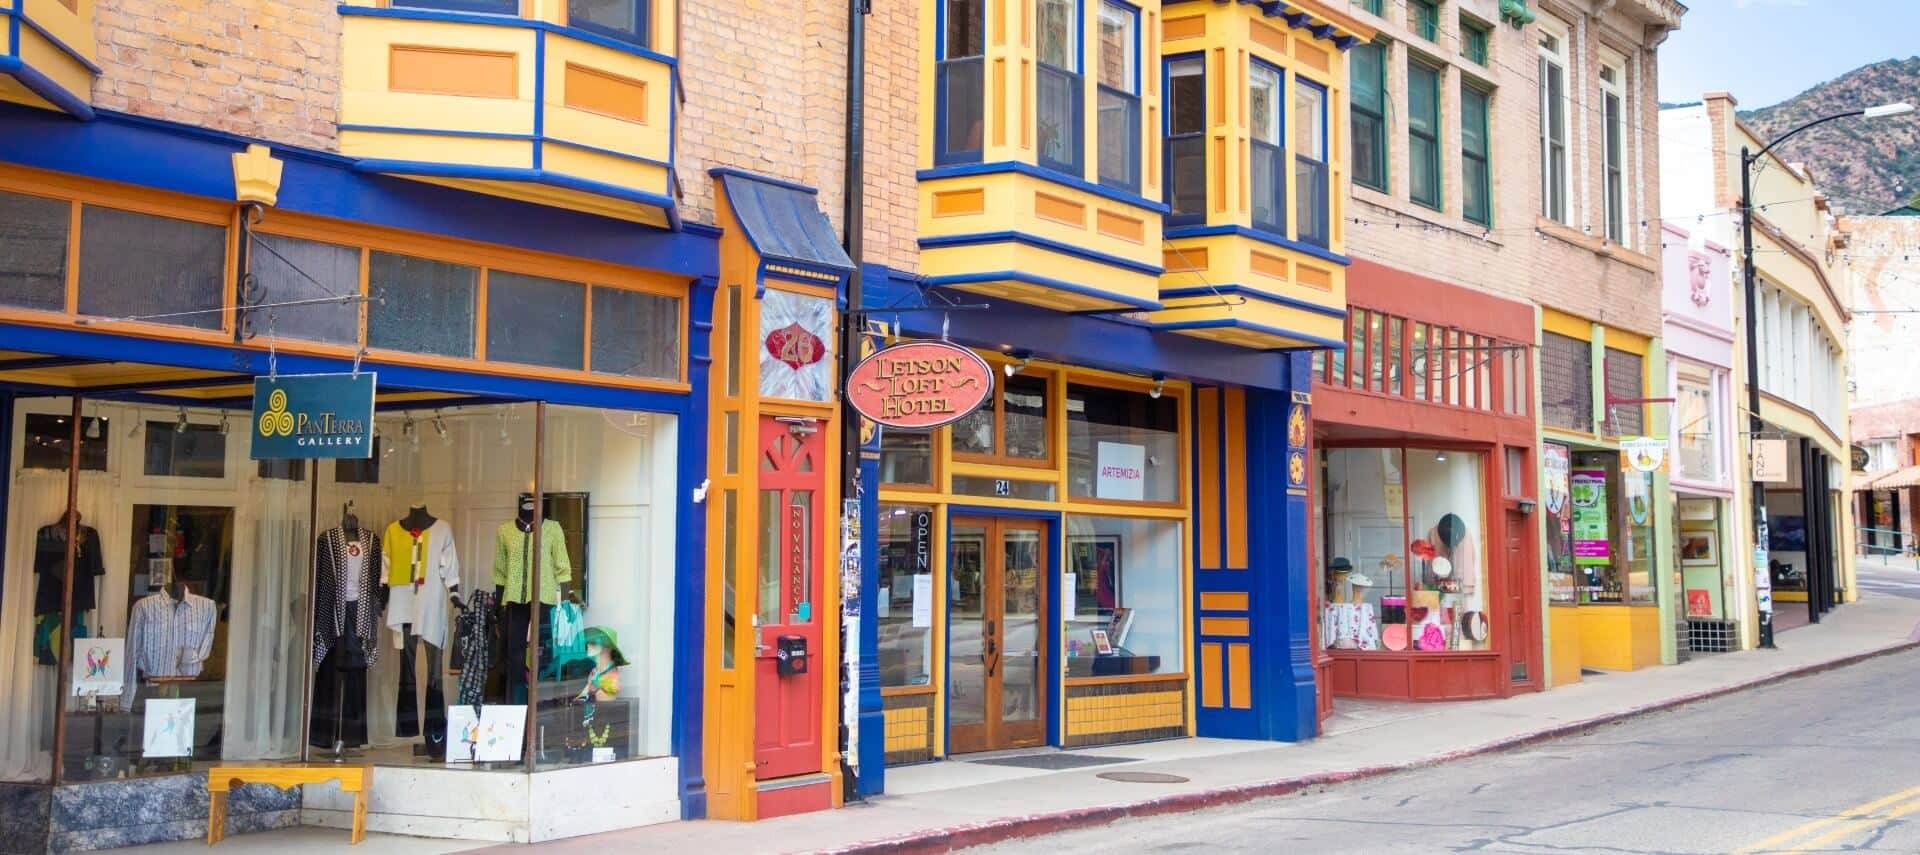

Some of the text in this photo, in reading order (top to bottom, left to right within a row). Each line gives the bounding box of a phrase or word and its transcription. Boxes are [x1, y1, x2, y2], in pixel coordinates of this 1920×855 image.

[297, 436, 362, 446] GALLERY
[1102, 465, 1140, 480] ARTEMIZIA
[996, 480, 1008, 495] 24
[917, 513, 929, 569] OPEN
[793, 510, 801, 605] NO VACANCY
